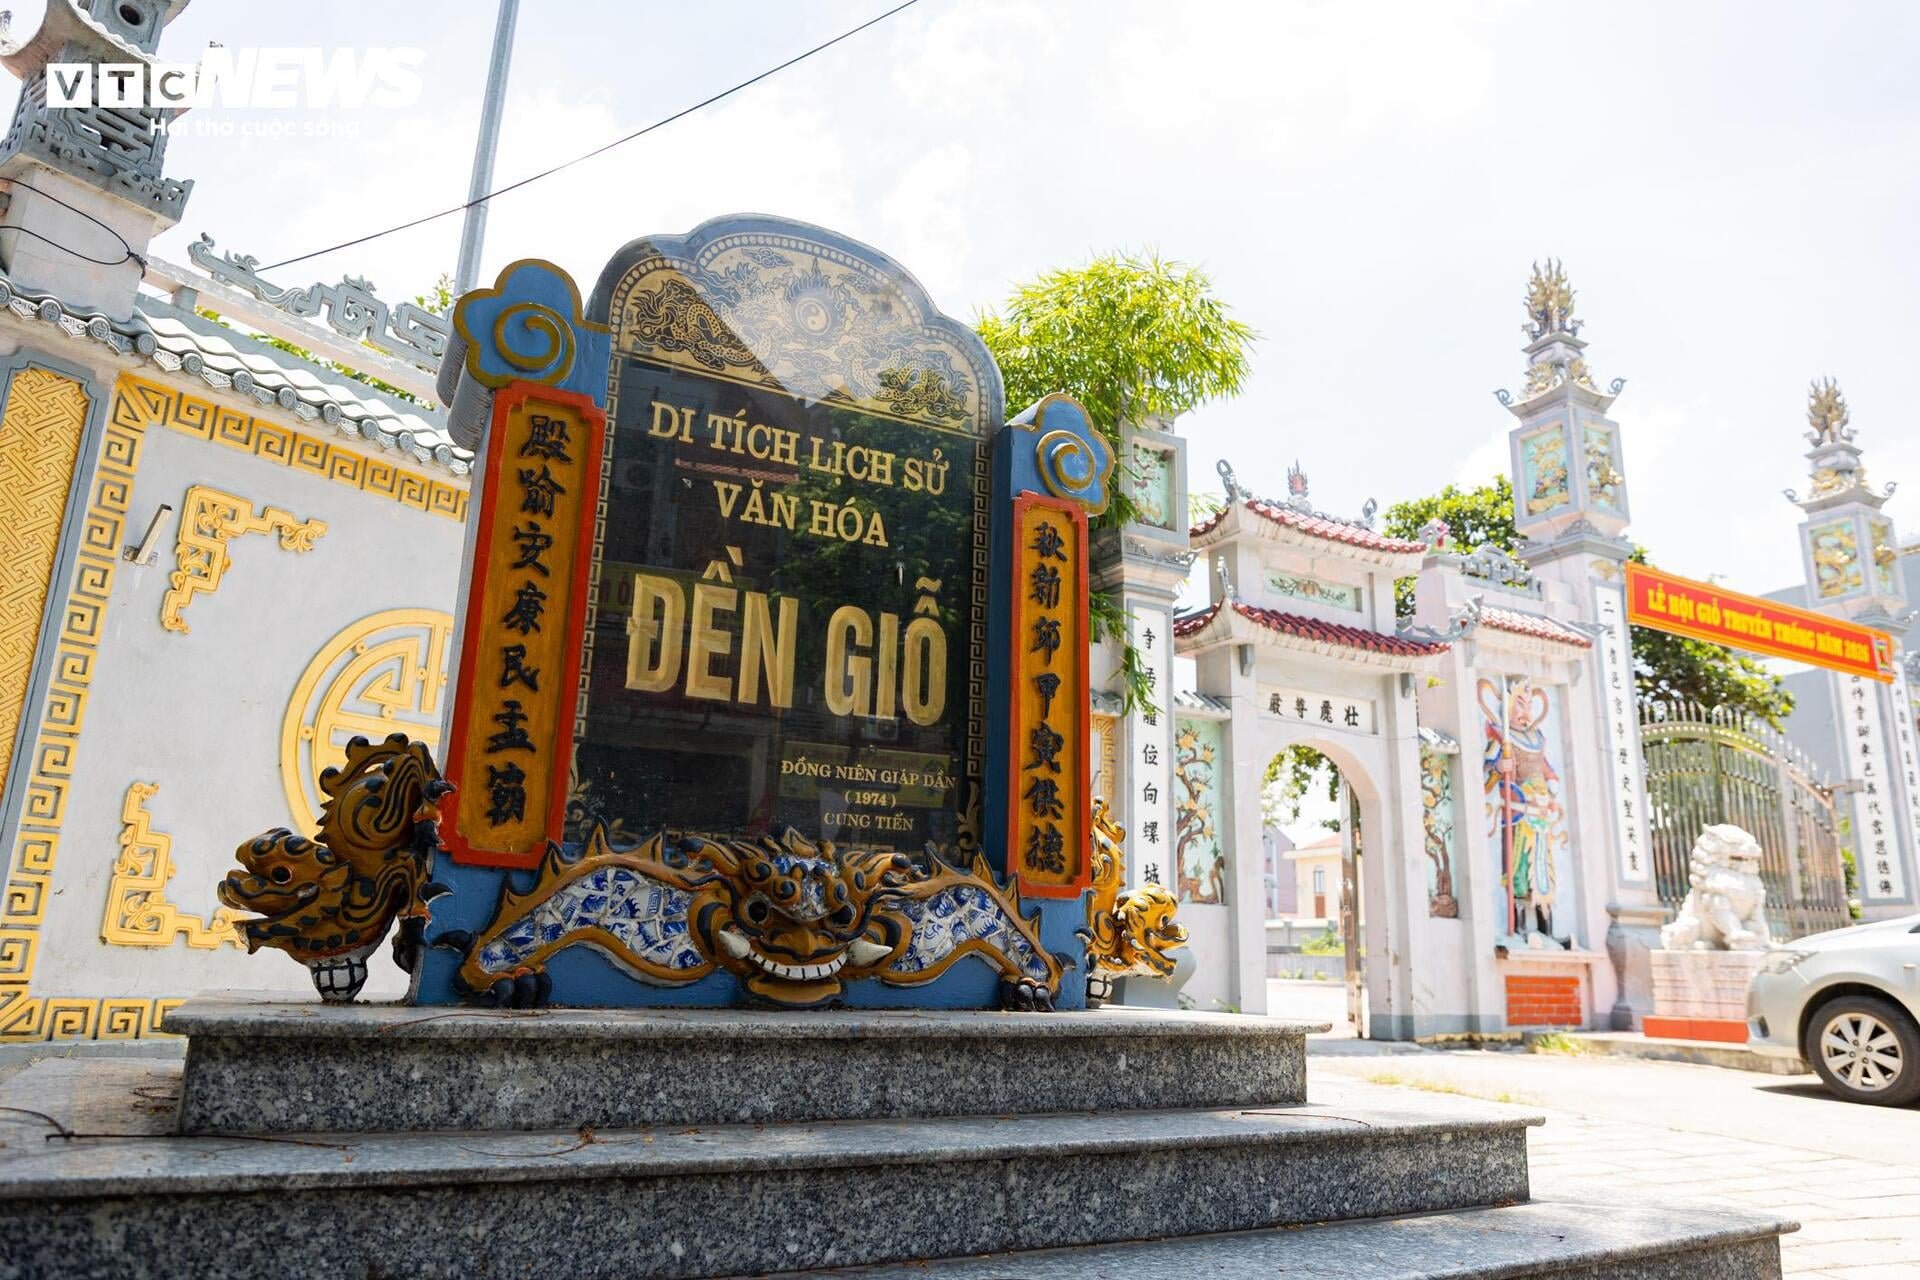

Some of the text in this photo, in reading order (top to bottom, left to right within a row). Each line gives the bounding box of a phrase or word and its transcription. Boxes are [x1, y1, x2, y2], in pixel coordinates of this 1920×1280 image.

[649, 400, 950, 496] DI TÍCH LỊCH SỬ
[713, 478, 889, 548] VĂN HÓA
[625, 545, 948, 726] ĐỀN GIỖ
[781, 756, 957, 789] ĐỒNG NIÊN GIÁP DẦN
[875, 813, 915, 832] TIẾN
